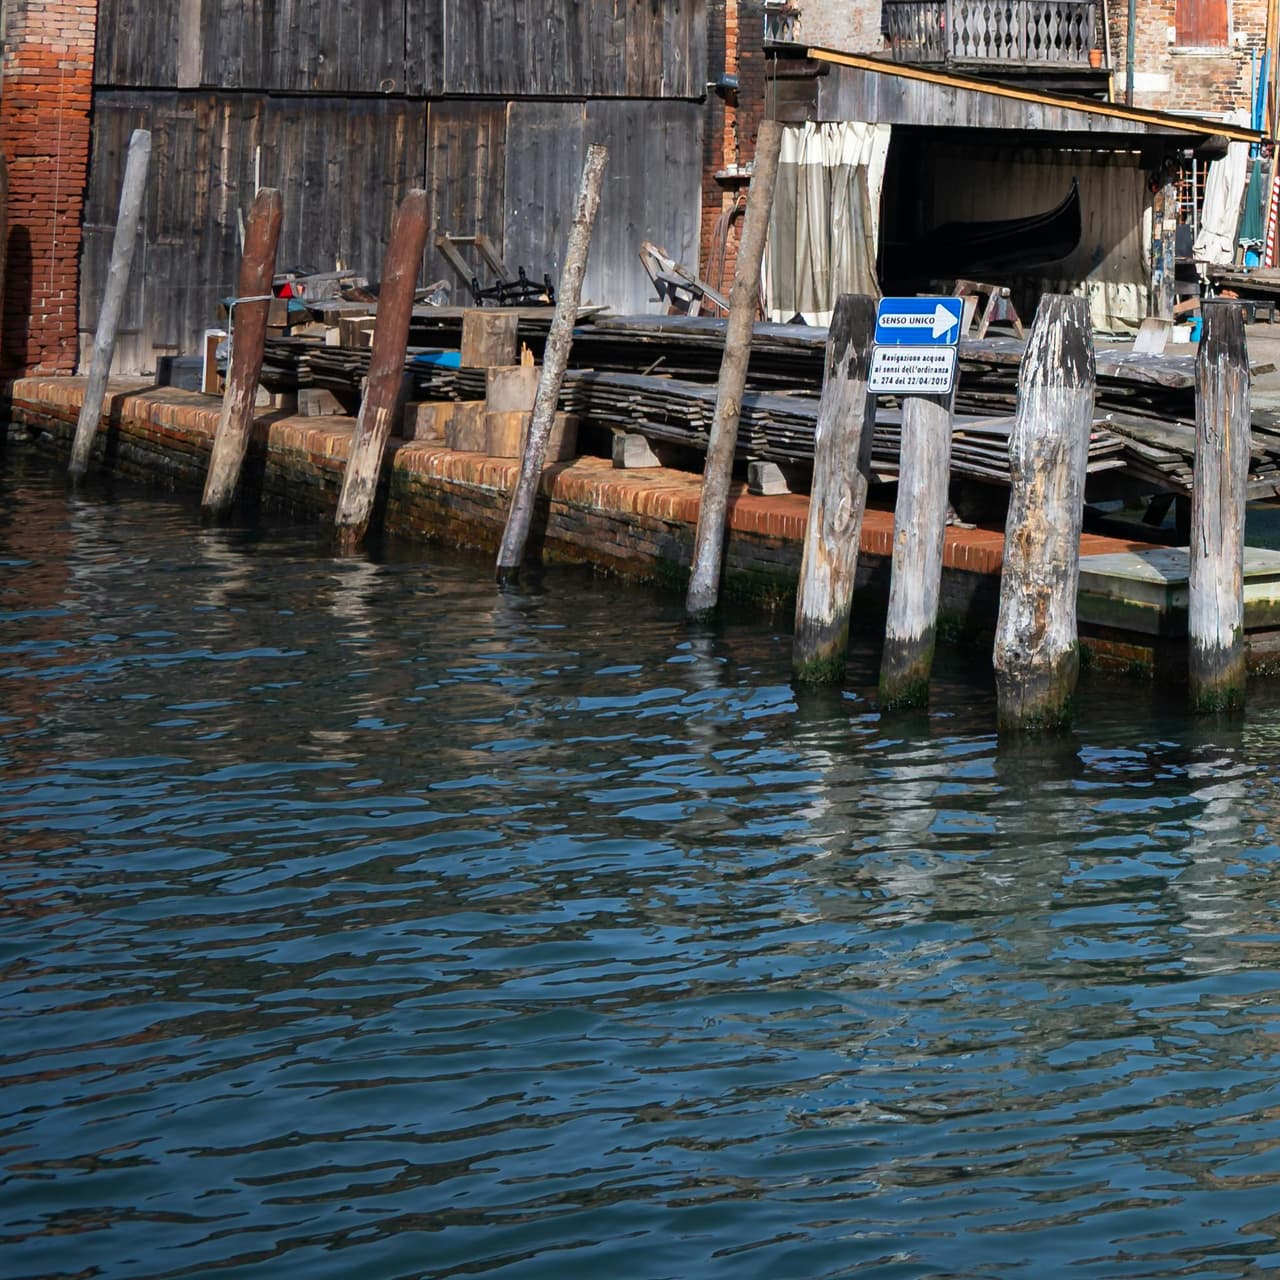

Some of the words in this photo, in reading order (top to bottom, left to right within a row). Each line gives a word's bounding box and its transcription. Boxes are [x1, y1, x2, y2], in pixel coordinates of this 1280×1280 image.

[882, 316, 907, 324] SENSO
[909, 316, 935, 324] UNICO
[882, 353, 921, 363] Navigazione
[923, 355, 945, 363] acquea
[875, 365, 882, 373] ai
[883, 365, 900, 373] sensi
[902, 365, 949, 373] dell'ordinanza
[881, 376, 893, 385] 274
[895, 376, 905, 385] del
[907, 376, 948, 385] 22/04/2015
